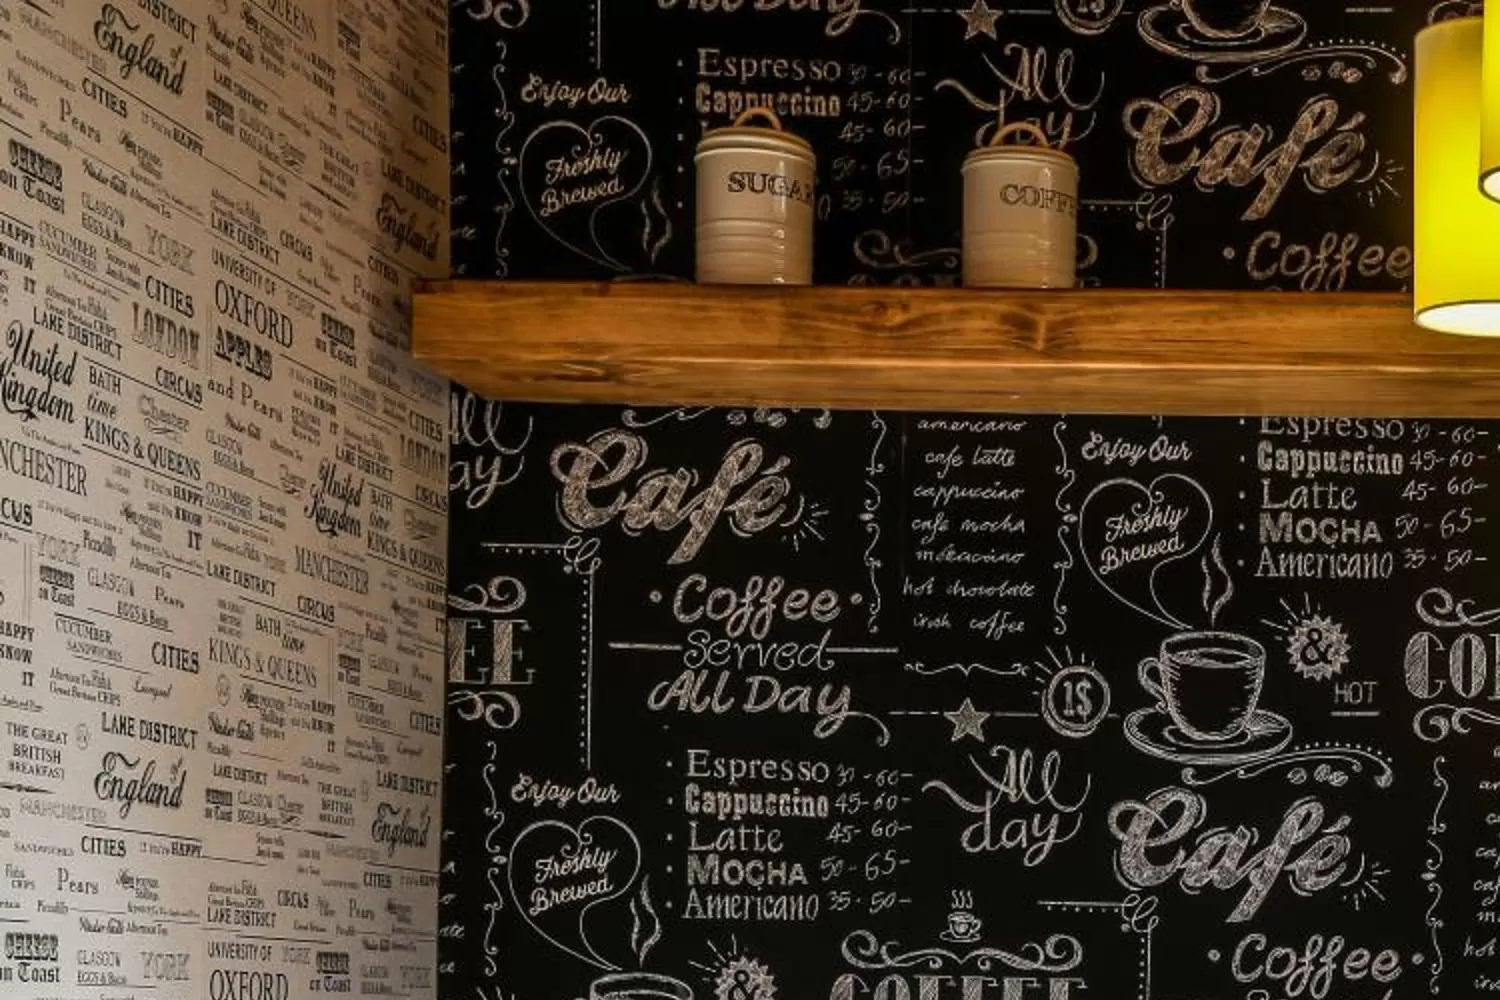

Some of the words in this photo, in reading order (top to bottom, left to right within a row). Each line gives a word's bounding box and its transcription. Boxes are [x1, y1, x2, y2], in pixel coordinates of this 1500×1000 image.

[93, 3, 188, 98] England
[696, 47, 843, 85] Espresso
[81, 76, 128, 119] CITIES
[520, 73, 580, 116] Enjoy
[544, 148, 629, 186] Freshly
[1122, 85, 1368, 222] Café
[540, 178, 625, 218] Brewed
[145, 274, 195, 319] CITIES
[215, 280, 294, 349] OXFORD
[32, 306, 65, 340] LAKE
[67, 315, 123, 361] DISTRICT
[88, 366, 121, 396] BATH
[83, 417, 129, 454] KINGS
[147, 446, 201, 480] QUEENS
[1256, 440, 1403, 477] Cappuccino
[549, 428, 793, 565] Café
[1261, 477, 1358, 512] Latte
[1257, 513, 1383, 545] MOCHA
[1254, 547, 1395, 580] Americano
[673, 574, 842, 641] Coffee
[151, 641, 199, 674] CITIES
[683, 630, 835, 671] Served
[647, 668, 736, 715] All
[746, 674, 852, 739] Day
[1333, 681, 1379, 705] HOT
[32, 726, 68, 746] GREAT
[101, 711, 134, 738] LAKE
[138, 720, 198, 751] DISTRICT
[13, 742, 61, 765] BRITISH
[686, 748, 830, 787] Espresso
[93, 751, 187, 819] England
[684, 783, 830, 822] Cappuccino
[80, 835, 127, 858] CITIES
[688, 820, 784, 853] Latte
[960, 796, 1083, 867] day
[533, 846, 620, 884] Freshly
[686, 853, 809, 886] MOCHA
[1108, 786, 1352, 923] Café
[57, 867, 99, 895] Pears
[529, 877, 615, 916] Brewed
[680, 885, 819, 922] Americano
[207, 941, 258, 962] UNIVERSITY
[1231, 934, 1402, 999] Coffee
